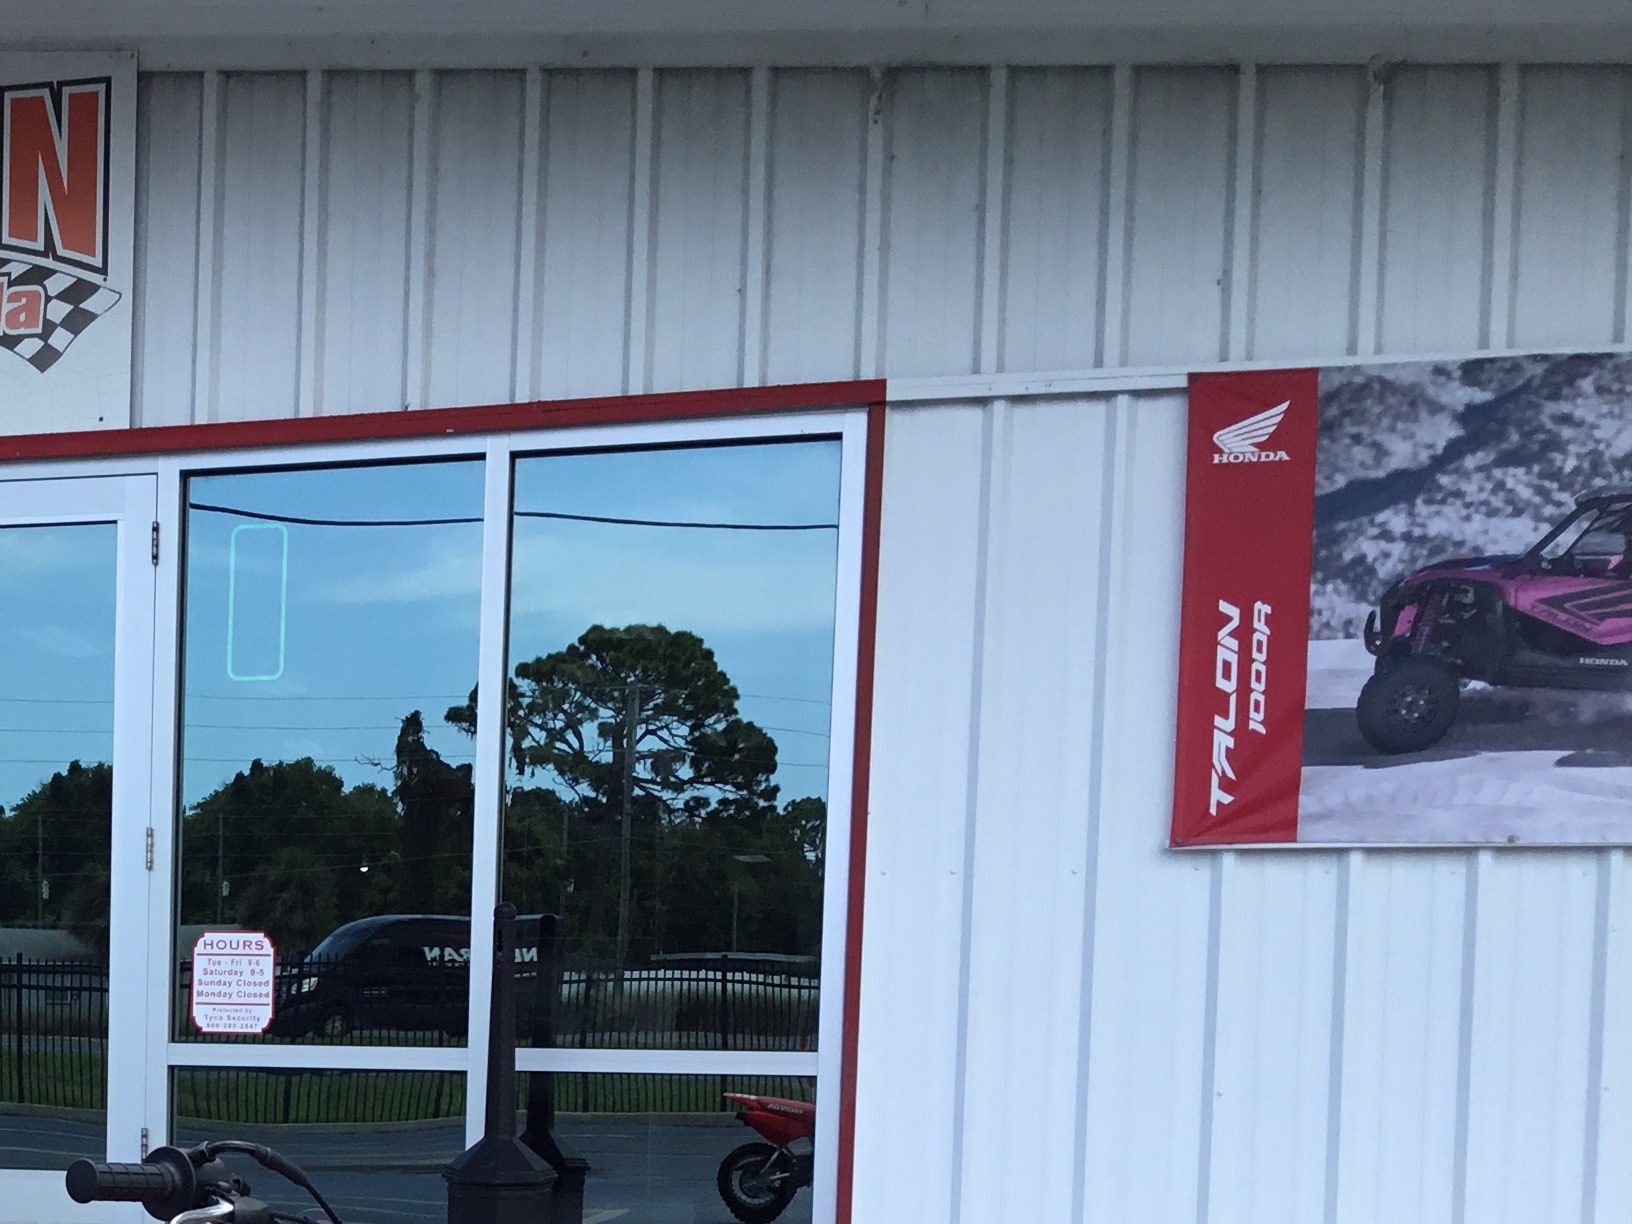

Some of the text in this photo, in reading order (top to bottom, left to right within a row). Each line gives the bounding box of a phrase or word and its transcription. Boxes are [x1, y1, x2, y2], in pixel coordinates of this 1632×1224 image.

[1213, 450, 1291, 464] HONDA
[1579, 657, 1629, 666] HONDA
[1248, 600, 1273, 736] 1000R
[1209, 599, 1242, 817] TALON
[203, 939, 265, 951] HOURS
[207, 958, 222, 967] Tue
[230, 958, 242, 967] Fri
[202, 967, 265, 978] Saturday 9-5
[197, 978, 270, 988] Sunday Closed
[196, 989, 270, 1000] Monday Closed
